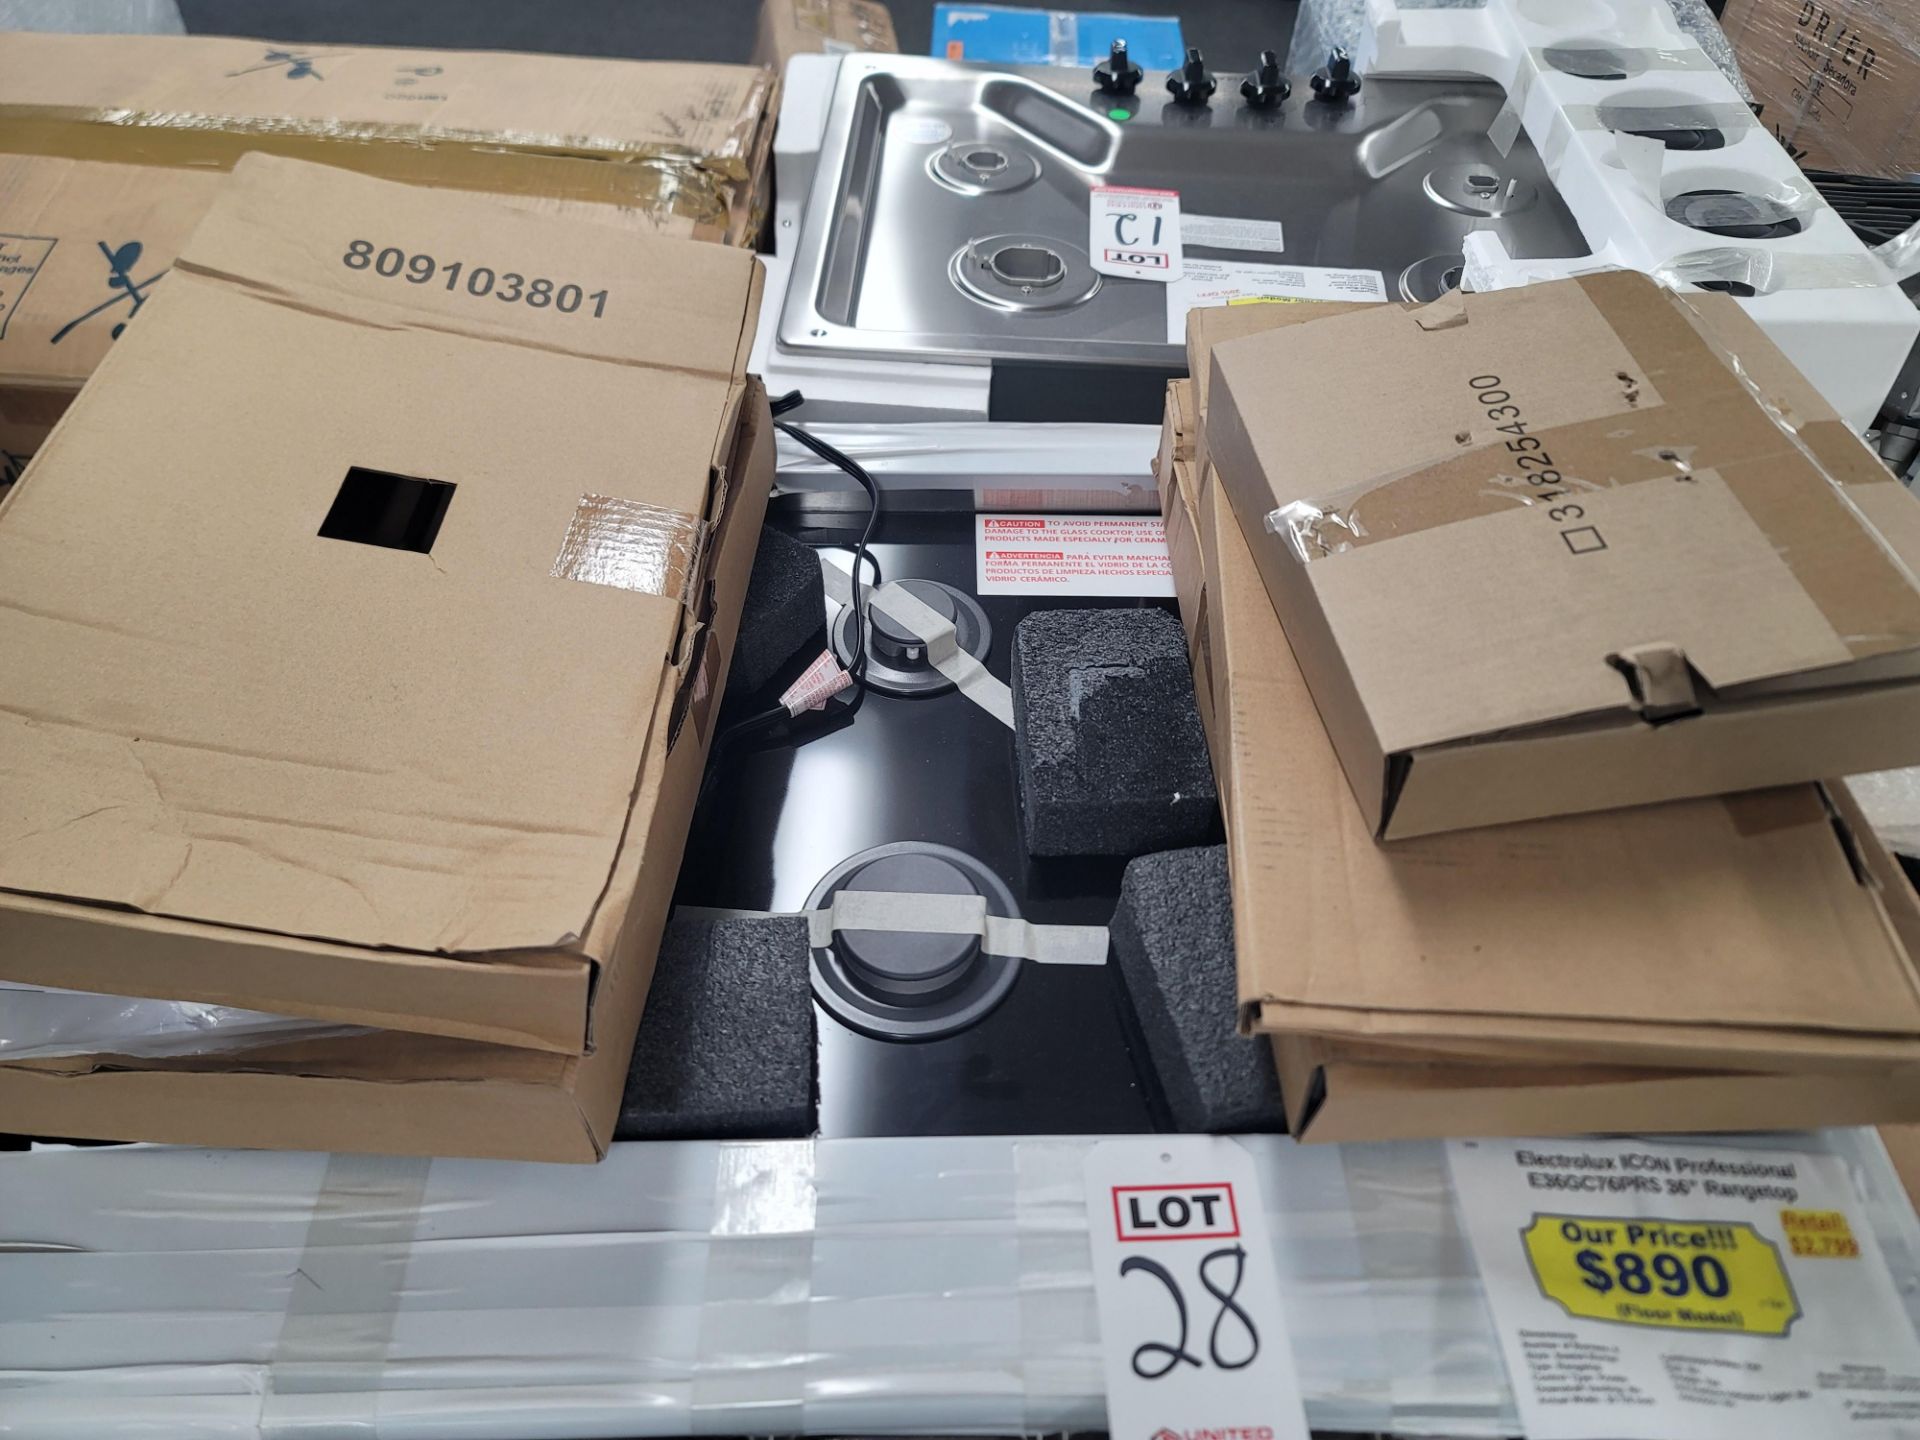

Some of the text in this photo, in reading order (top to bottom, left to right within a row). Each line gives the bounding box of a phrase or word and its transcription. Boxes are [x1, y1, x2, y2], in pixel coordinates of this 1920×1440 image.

[1105, 212, 1162, 246] 12
[1111, 253, 1161, 265] LOT
[343, 240, 609, 319] 809103801
[1469, 375, 1585, 522] 318254300
[1000, 520, 1041, 528] CAUTION
[1020, 574, 1070, 583] CERÁMICO.
[1515, 1150, 1798, 1180] Electrolux ICON Professional
[1704, 1179, 1799, 1203] Rangetop
[1129, 1195, 1221, 1229] LOT
[1561, 1221, 1739, 1251] Our Price!!!
[1575, 1249, 1730, 1300] $890
[1120, 1243, 1260, 1381] 28
[1183, 1426, 1275, 1440] UNITED
